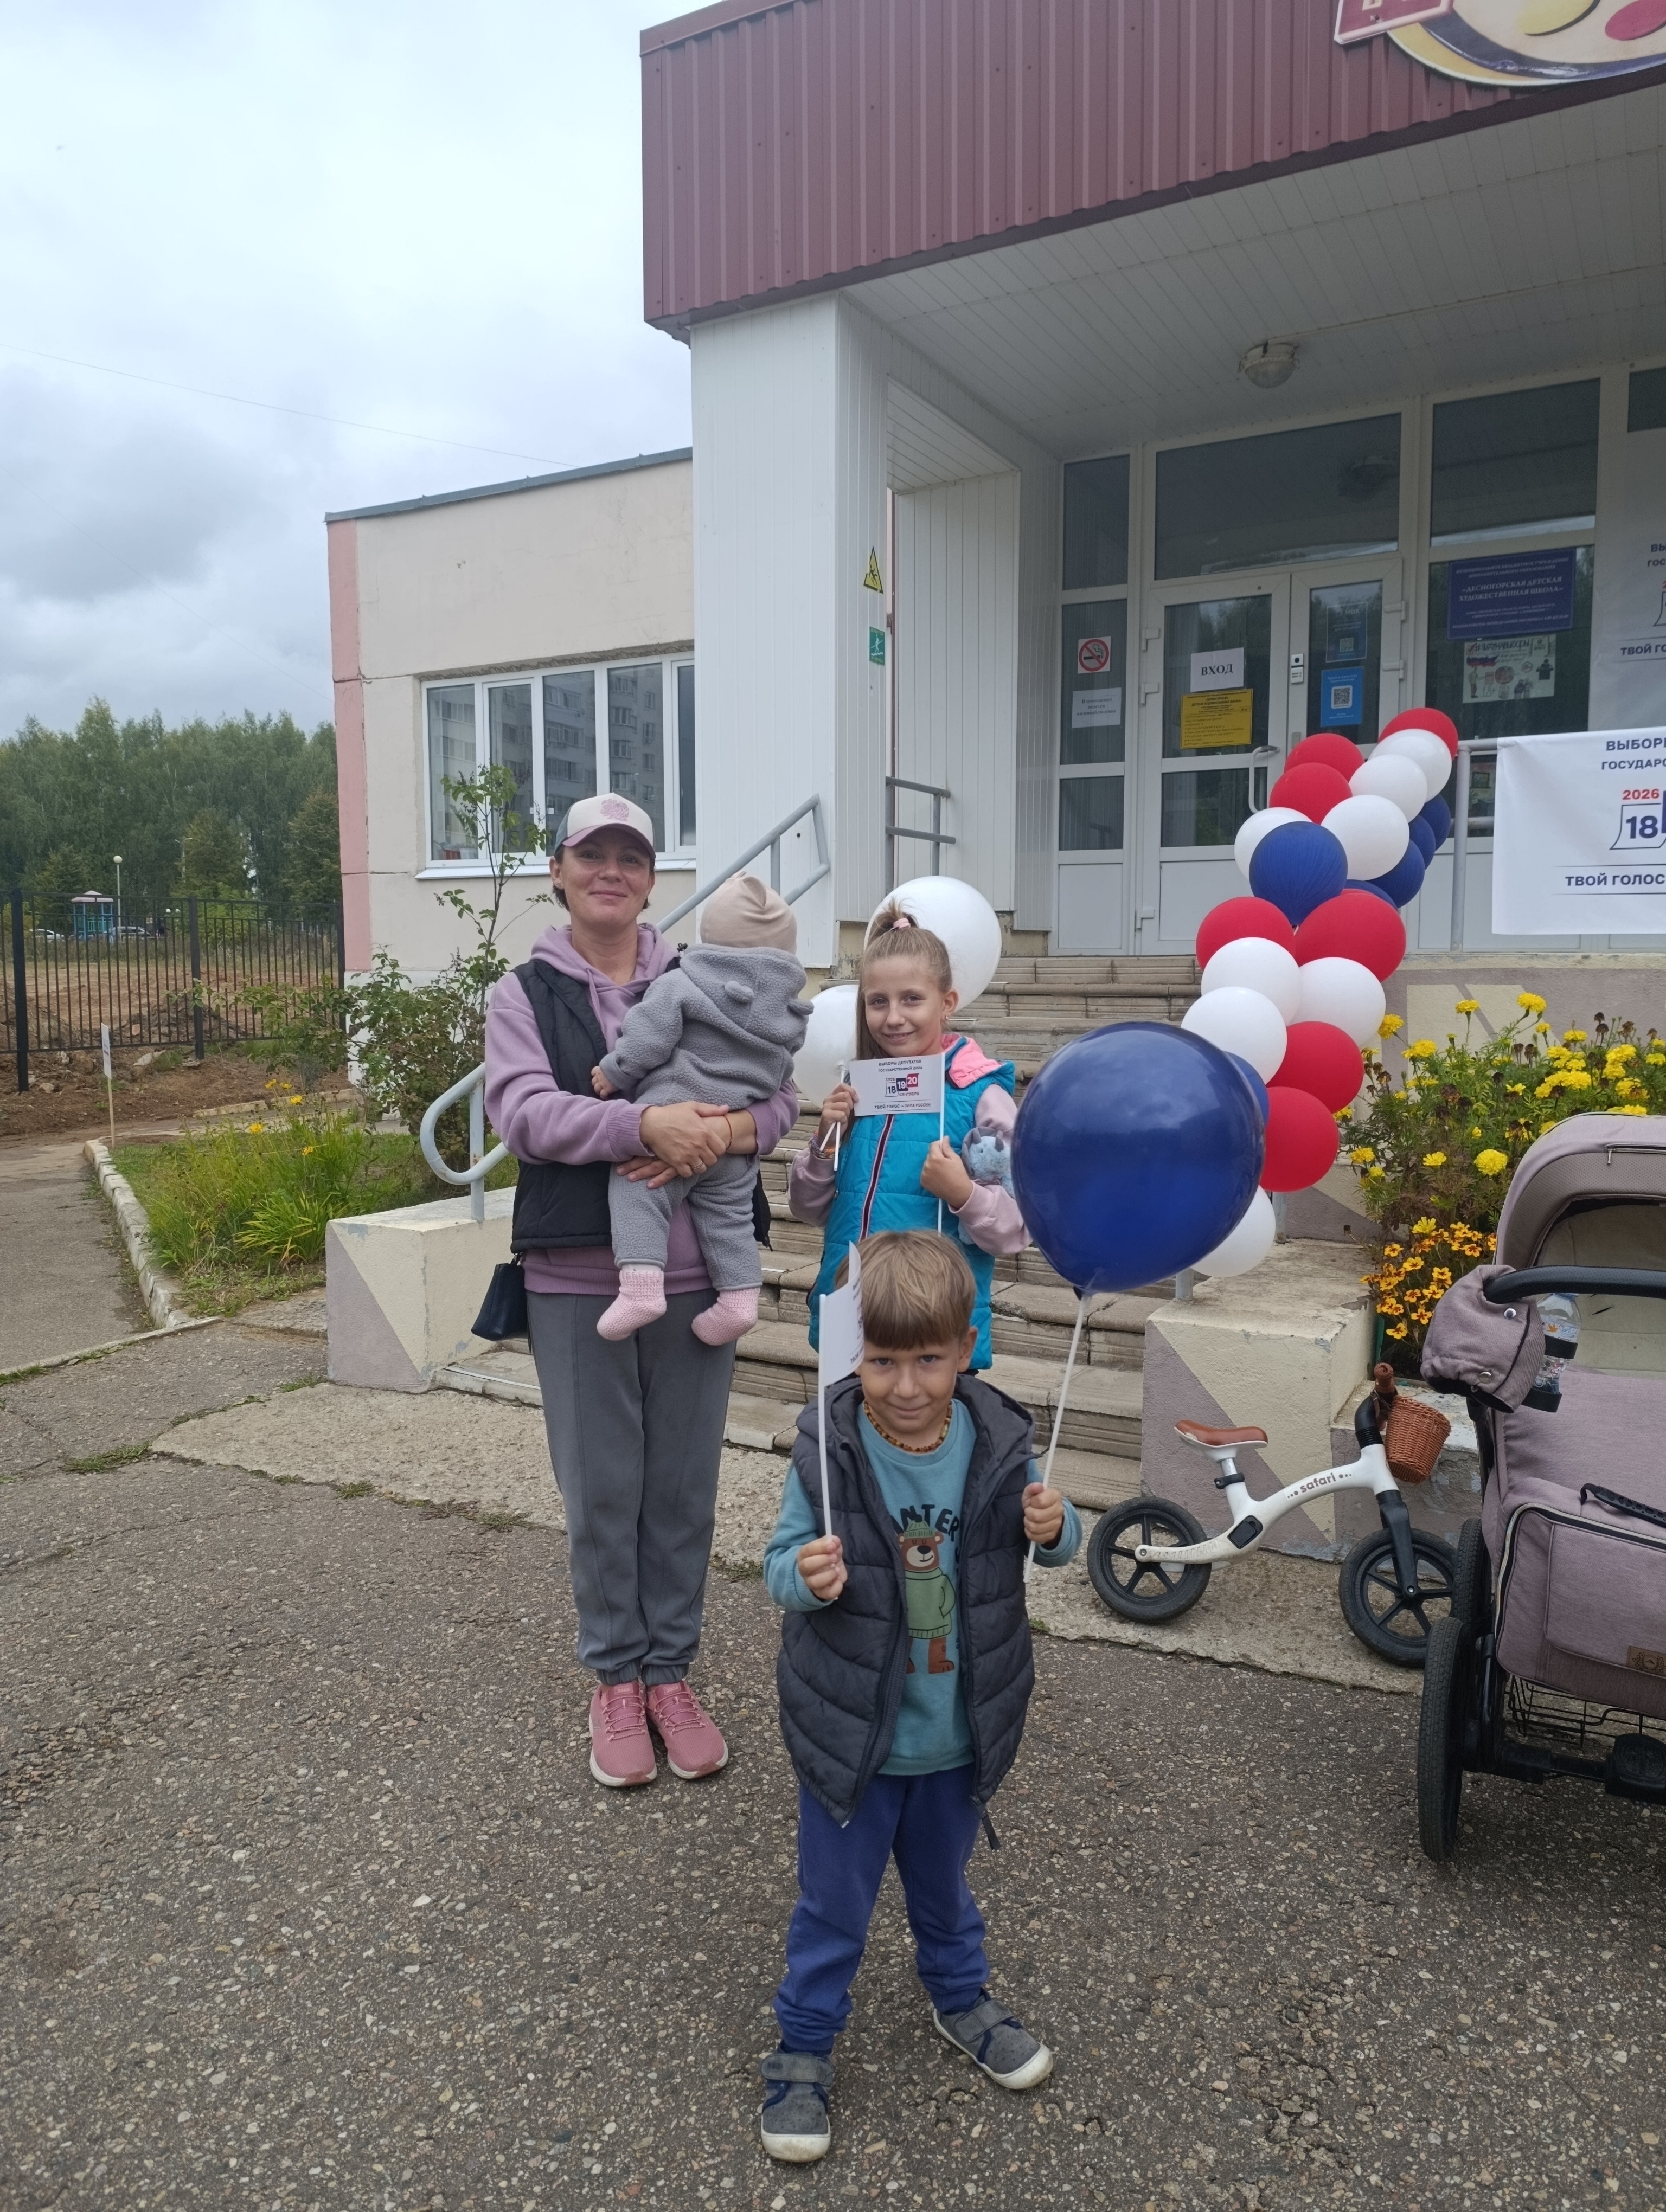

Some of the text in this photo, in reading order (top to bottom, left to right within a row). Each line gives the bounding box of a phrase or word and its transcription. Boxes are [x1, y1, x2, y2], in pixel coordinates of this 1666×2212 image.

[1527, 576, 1562, 586] ДЕТСКАЯ
[1459, 589, 1529, 602] ХУДОЖЕСТВЕННАЯ
[1620, 643, 1651, 655] ТВОЙ
[1201, 664, 1233, 676] ВХОД
[1606, 738, 1666, 751] ВЫБОР
[1622, 788, 1659, 800] 2026
[1626, 815, 1658, 839] 18
[1565, 873, 1665, 886] ТВОЙ ГОЛОС
[897, 1081, 906, 1089] 19
[907, 1076, 917, 1085] 20
[1300, 1472, 1336, 1493] safari
